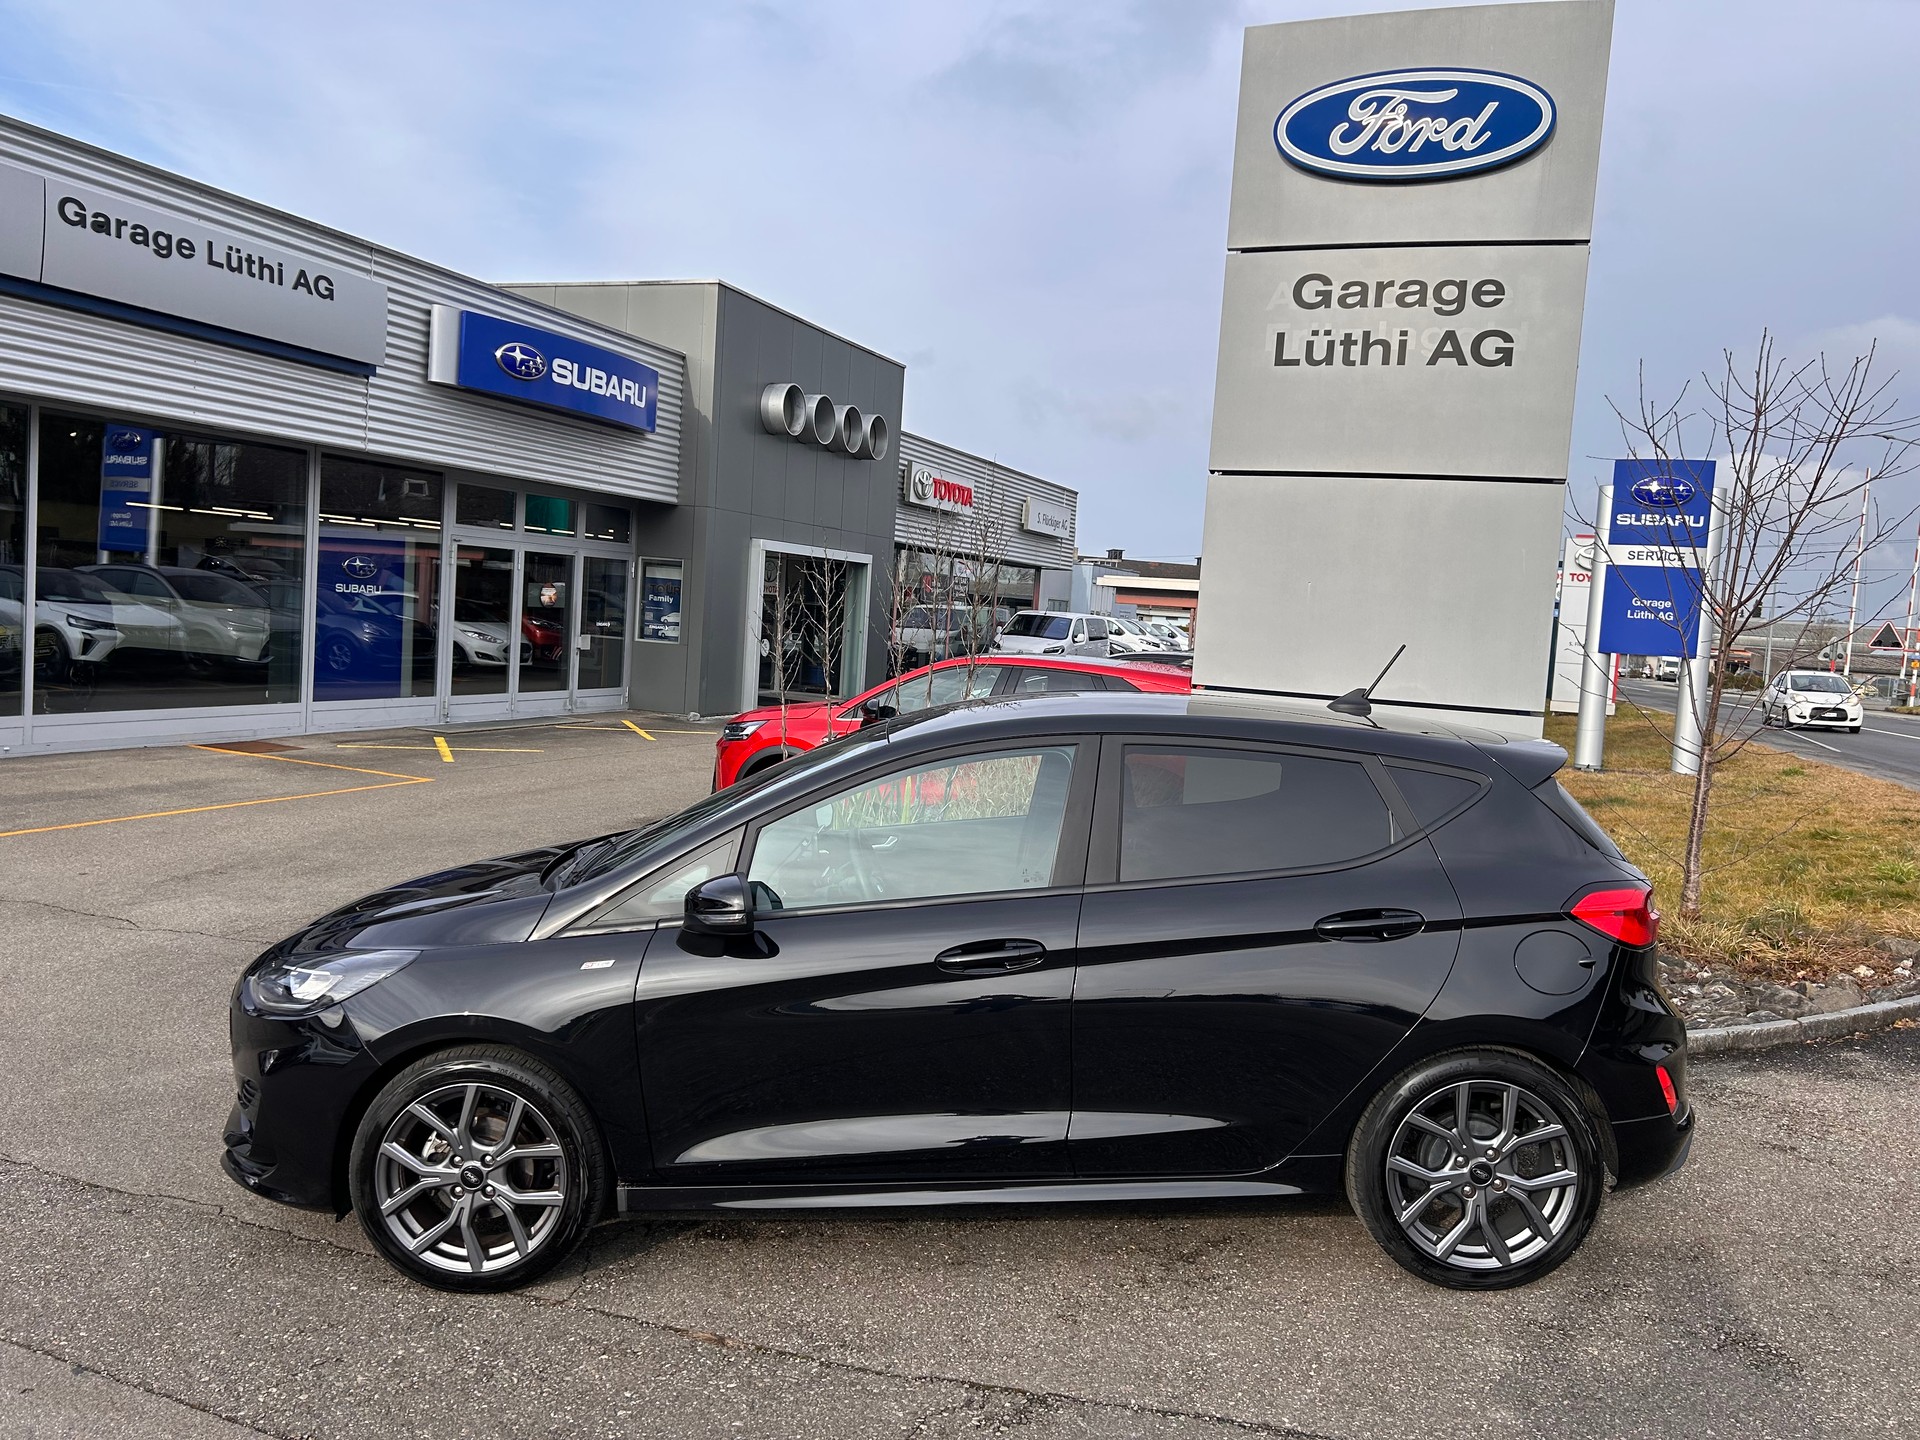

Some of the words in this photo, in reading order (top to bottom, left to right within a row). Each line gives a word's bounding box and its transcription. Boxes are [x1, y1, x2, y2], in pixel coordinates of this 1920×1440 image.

[1329, 88, 1499, 155] Ford
[57, 196, 196, 259] Garage
[206, 240, 284, 286] Lüthi
[291, 269, 335, 301] AG
[1292, 273, 1506, 317] Garage
[1273, 329, 1410, 367] Lüthi
[1426, 329, 1515, 367] AG
[551, 357, 647, 408] SUBARU
[932, 477, 973, 508] TOYOTA
[1060, 519, 1068, 531] AG
[1616, 513, 1705, 528] SUBARU
[1627, 550, 1686, 562] SERVICE
[335, 583, 382, 594] SUBARU
[648, 594, 674, 604] Family
[1631, 598, 1672, 610] Garage
[1657, 611, 1674, 621] AG
